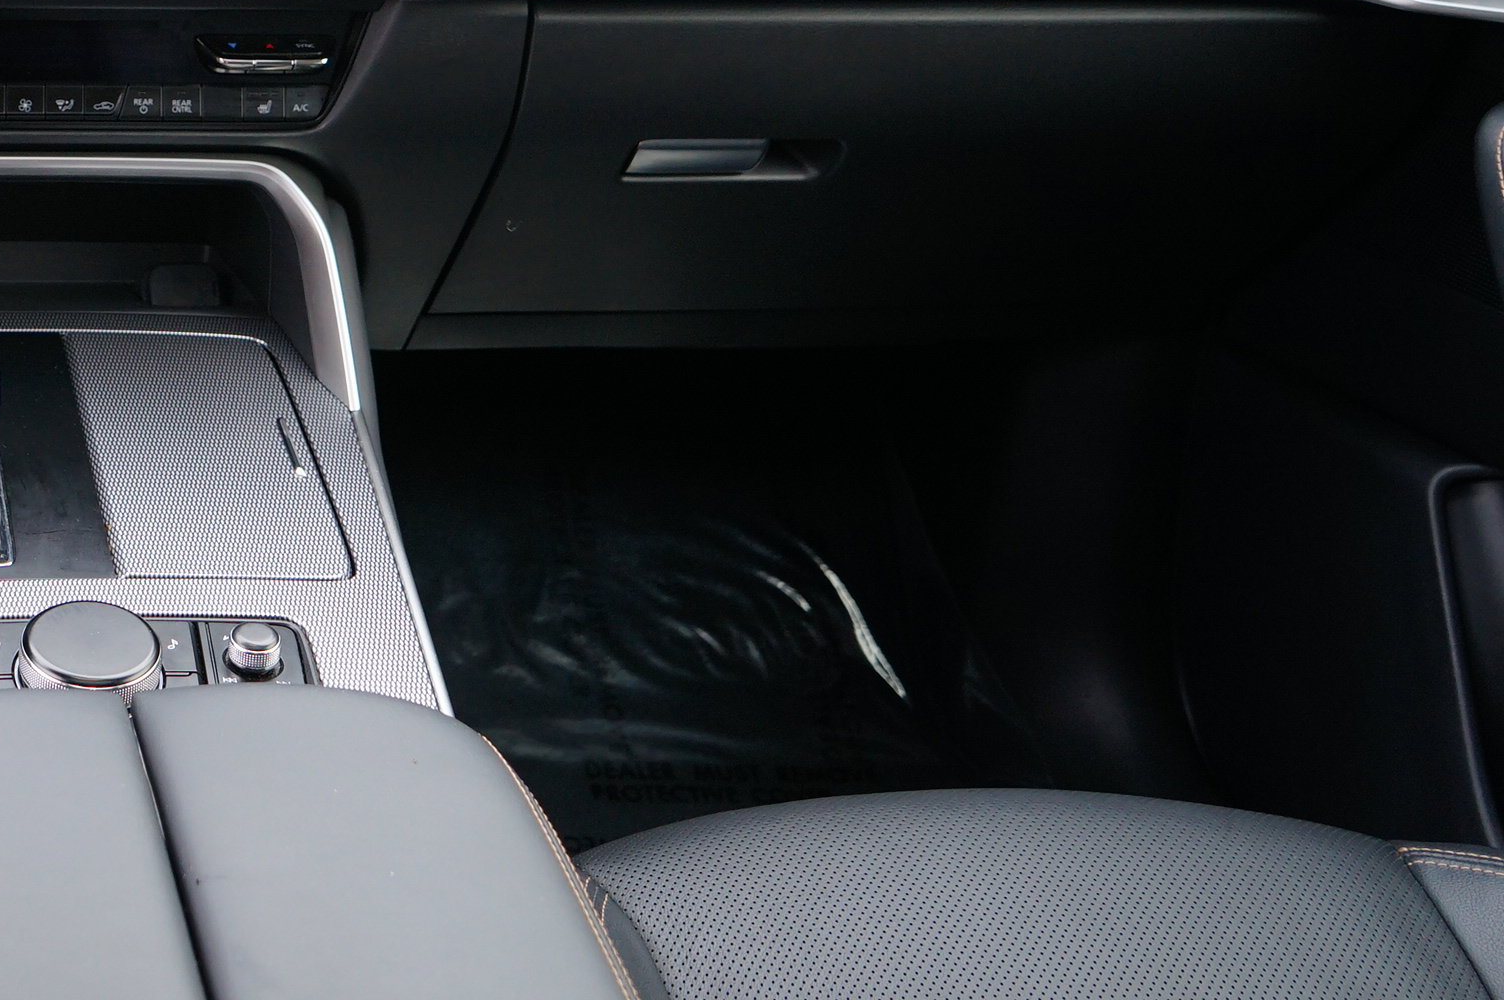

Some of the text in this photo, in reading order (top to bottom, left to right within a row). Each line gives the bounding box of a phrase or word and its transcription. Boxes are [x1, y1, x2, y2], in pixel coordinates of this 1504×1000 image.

[133, 98, 154, 106] REAR
[171, 99, 193, 107] REAR
[171, 106, 193, 114] CNTRL
[292, 103, 309, 112] A/C
